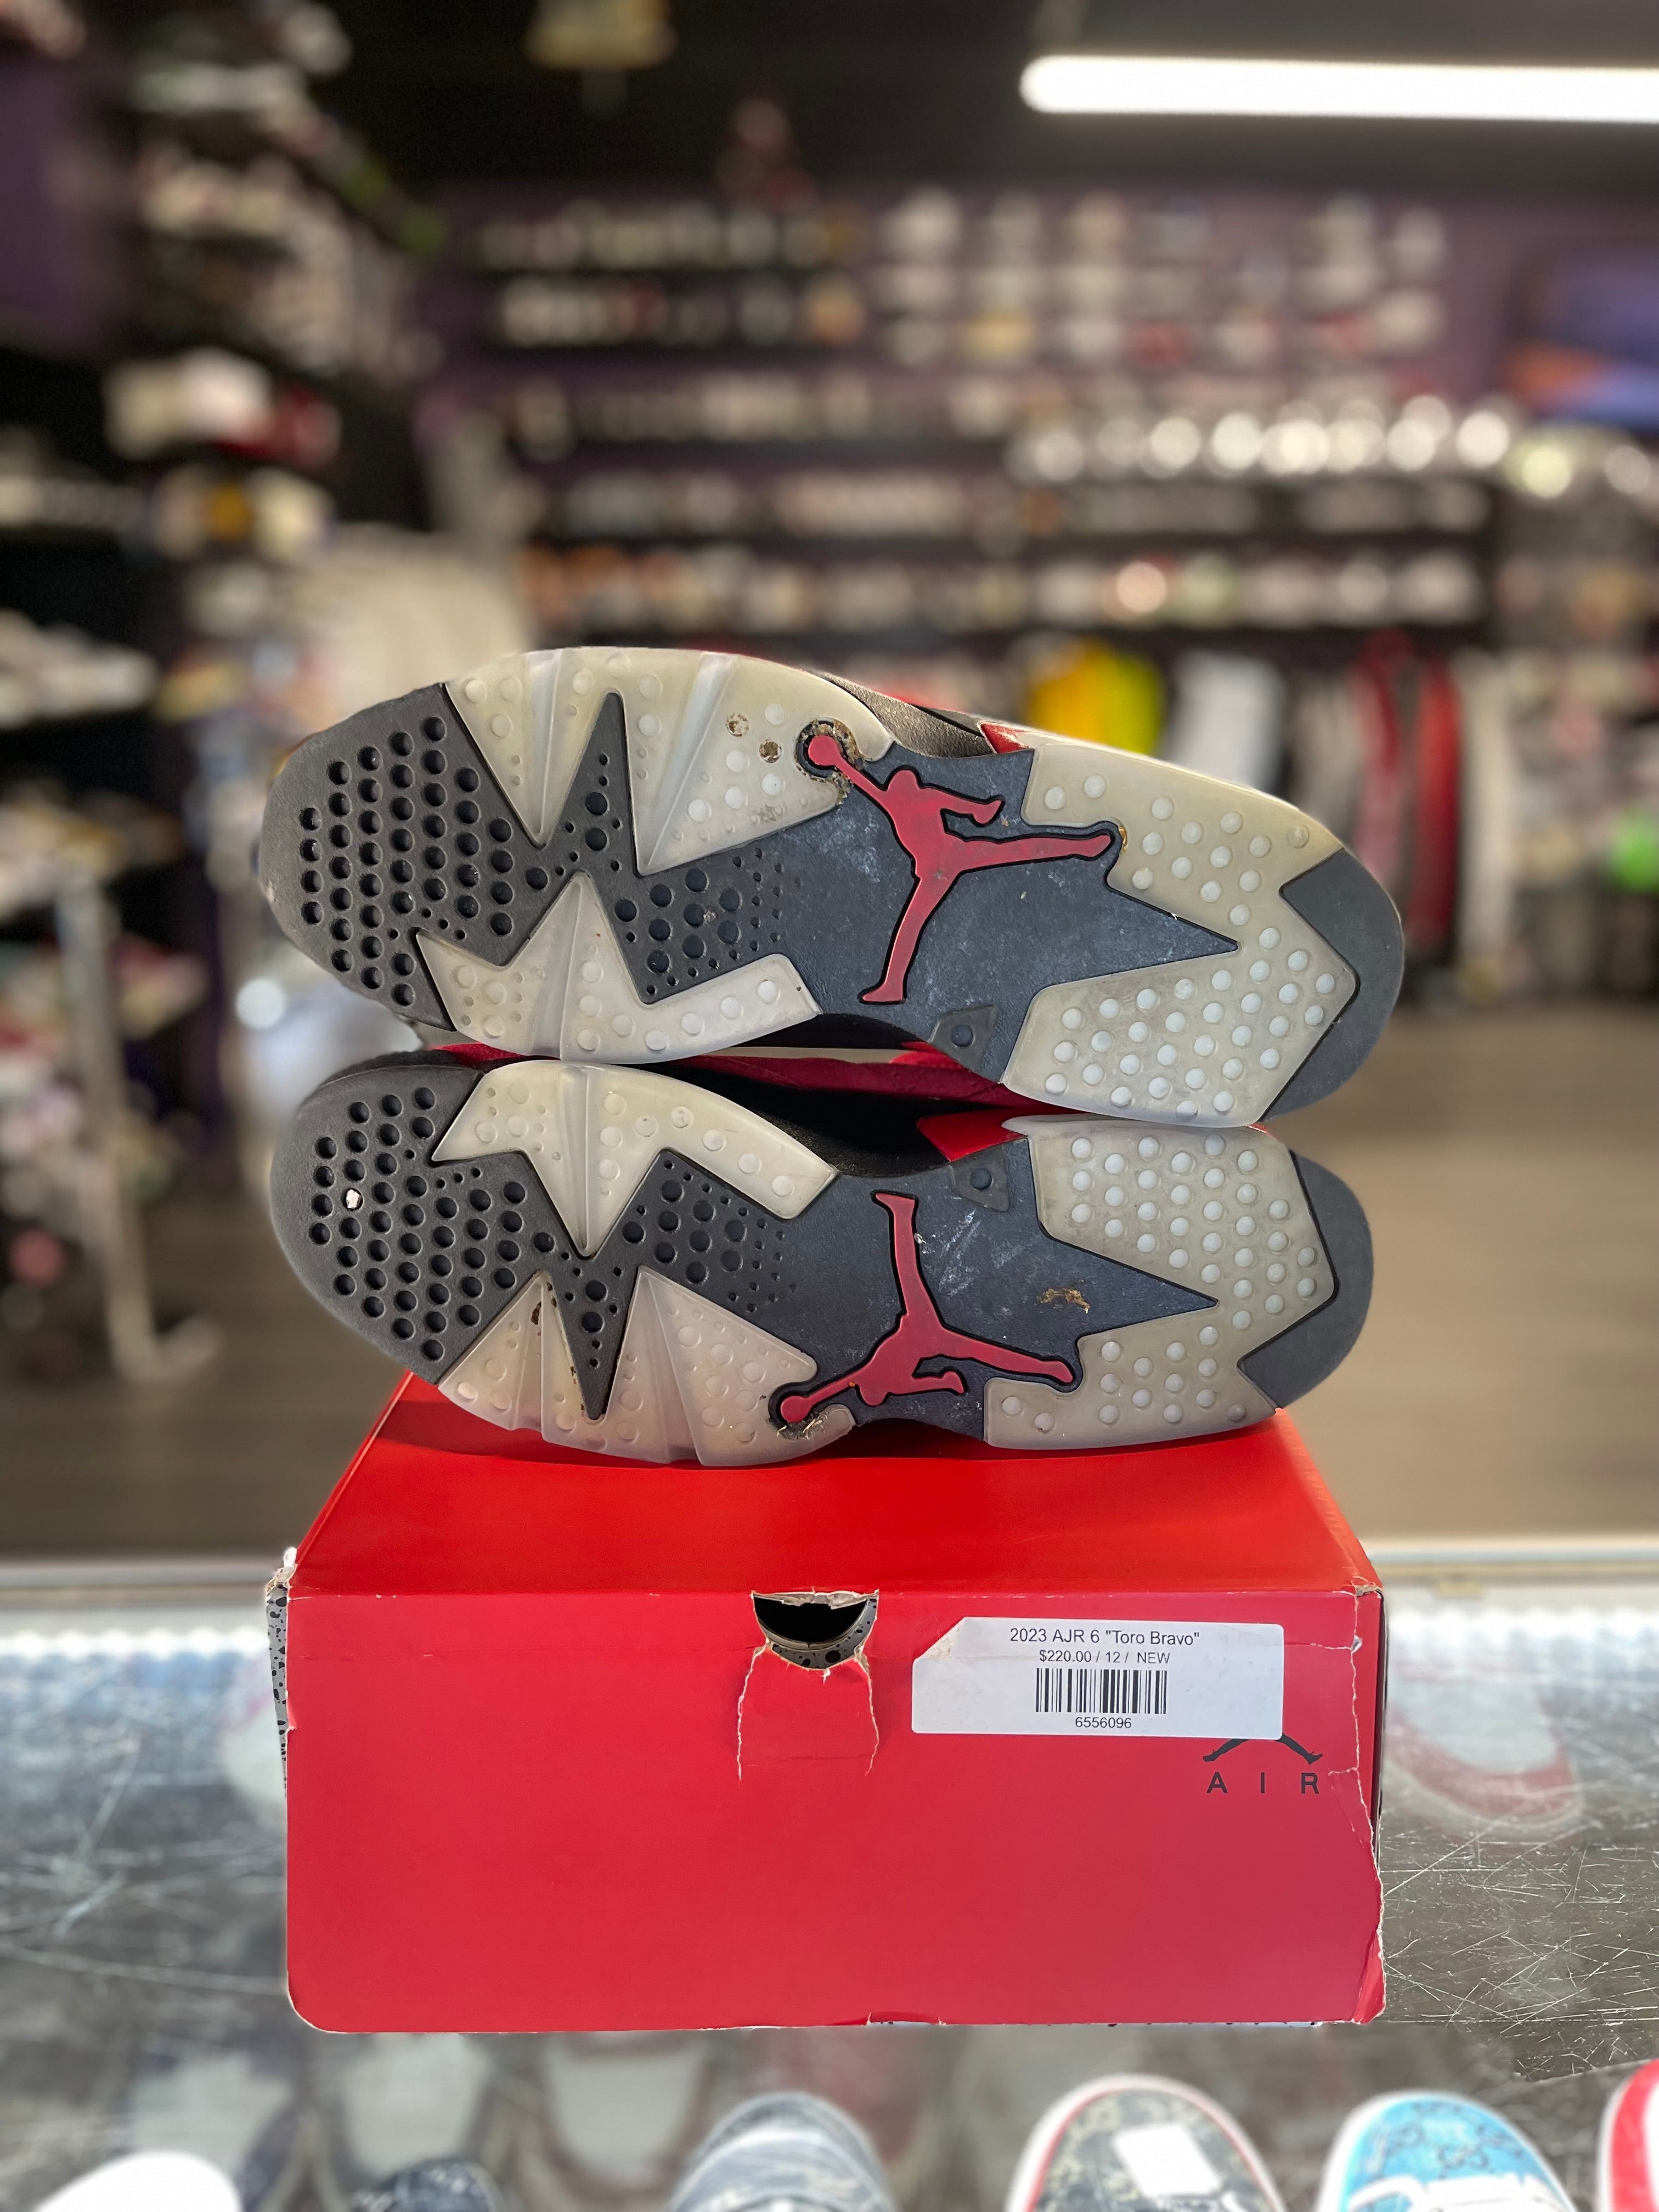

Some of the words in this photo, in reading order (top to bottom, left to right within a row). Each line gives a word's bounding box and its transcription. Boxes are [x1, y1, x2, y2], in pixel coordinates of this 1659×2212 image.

[1009, 1628, 1047, 1642] 2023
[1052, 1629, 1085, 1643] AJR
[1090, 1629, 1100, 1643] 6
[1105, 1630, 1145, 1644] "Toro
[1150, 1631, 1200, 1646] Bravo"
[1039, 1650, 1092, 1663] $220.00
[1096, 1651, 1101, 1663] /
[1105, 1651, 1121, 1663] 12
[1124, 1652, 1129, 1663] /
[1137, 1652, 1171, 1664] NEW
[1075, 1717, 1132, 1729] 6556096
[1207, 1772, 1319, 1794] AIR
